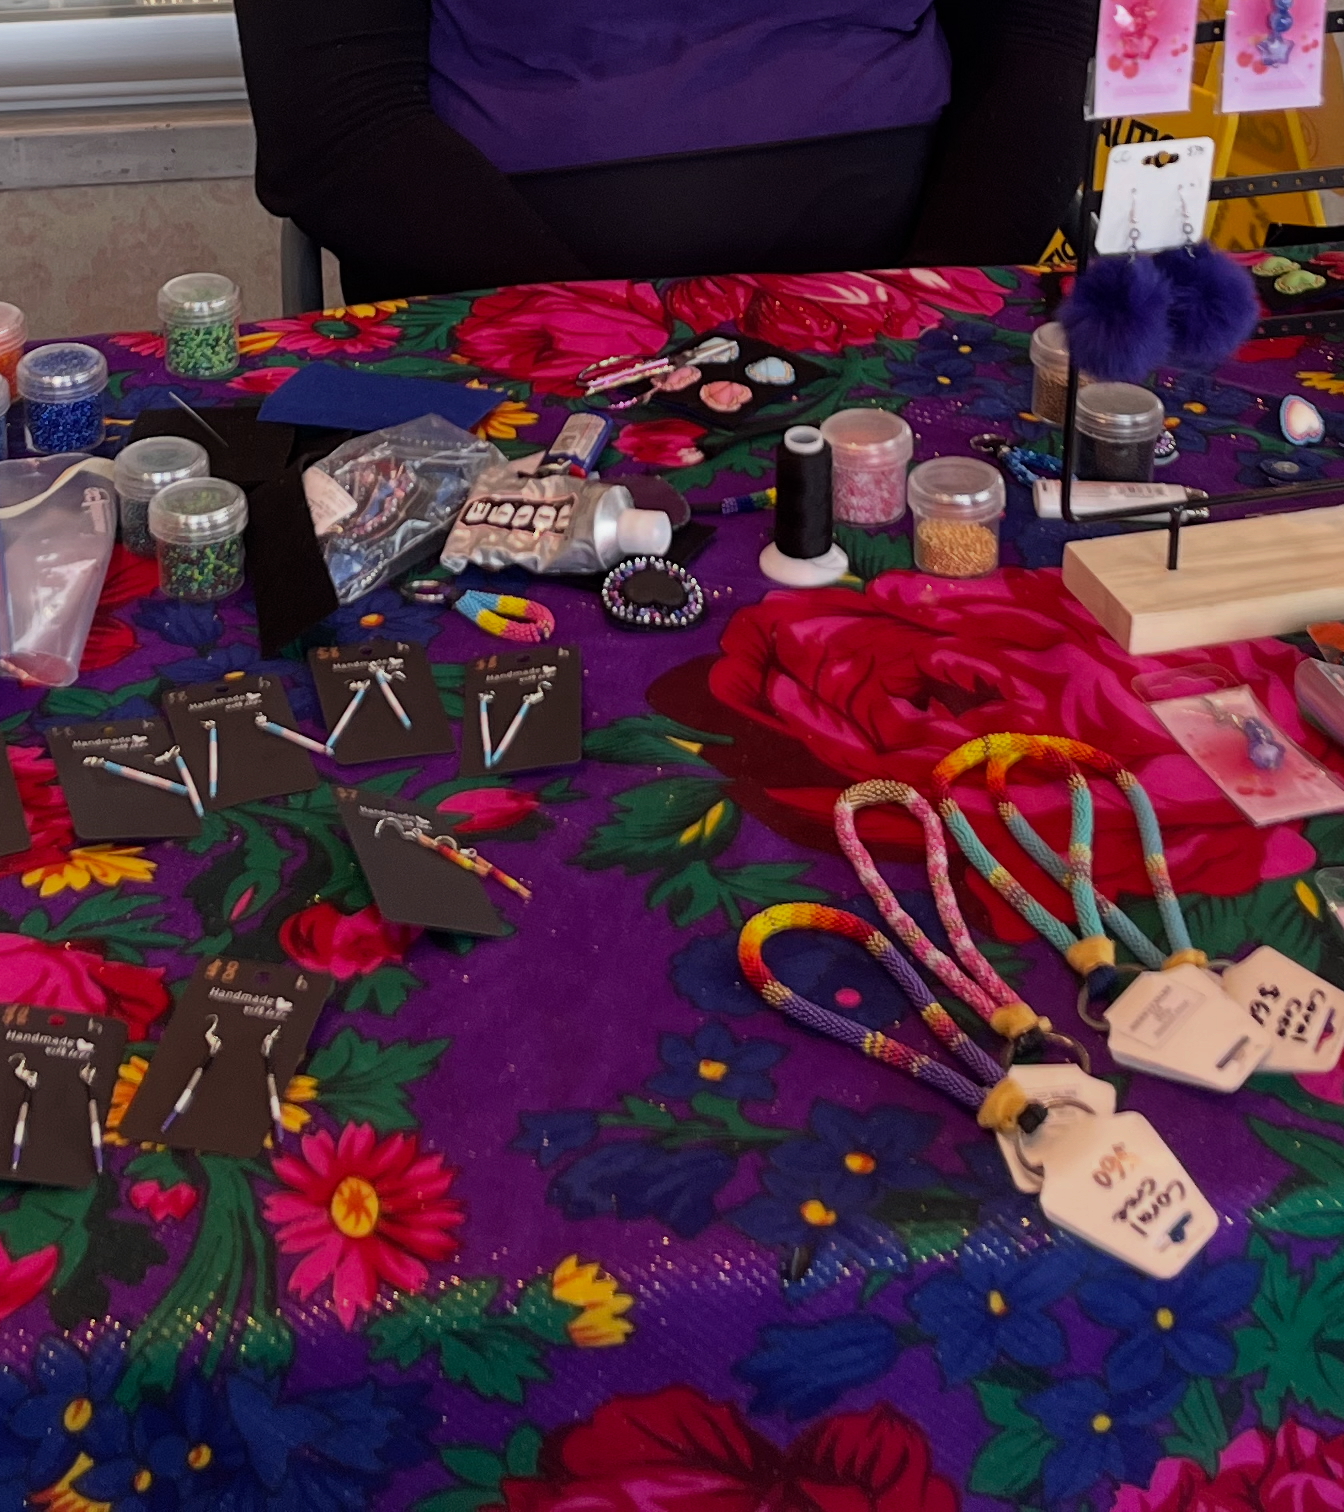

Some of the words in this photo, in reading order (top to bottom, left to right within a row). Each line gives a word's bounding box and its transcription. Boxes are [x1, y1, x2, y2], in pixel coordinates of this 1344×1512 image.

[332, 660, 388, 672] Handmade
[486, 668, 542, 682] Handmade
[189, 697, 246, 711] Handmade
[72, 736, 131, 749] Handmade
[358, 805, 417, 822] Handmade
[209, 987, 275, 1006] Handmade
[6, 1030, 76, 1049] Handmade
[1113, 1178, 1156, 1223] Cree
[1128, 1180, 1185, 1236] Coral
